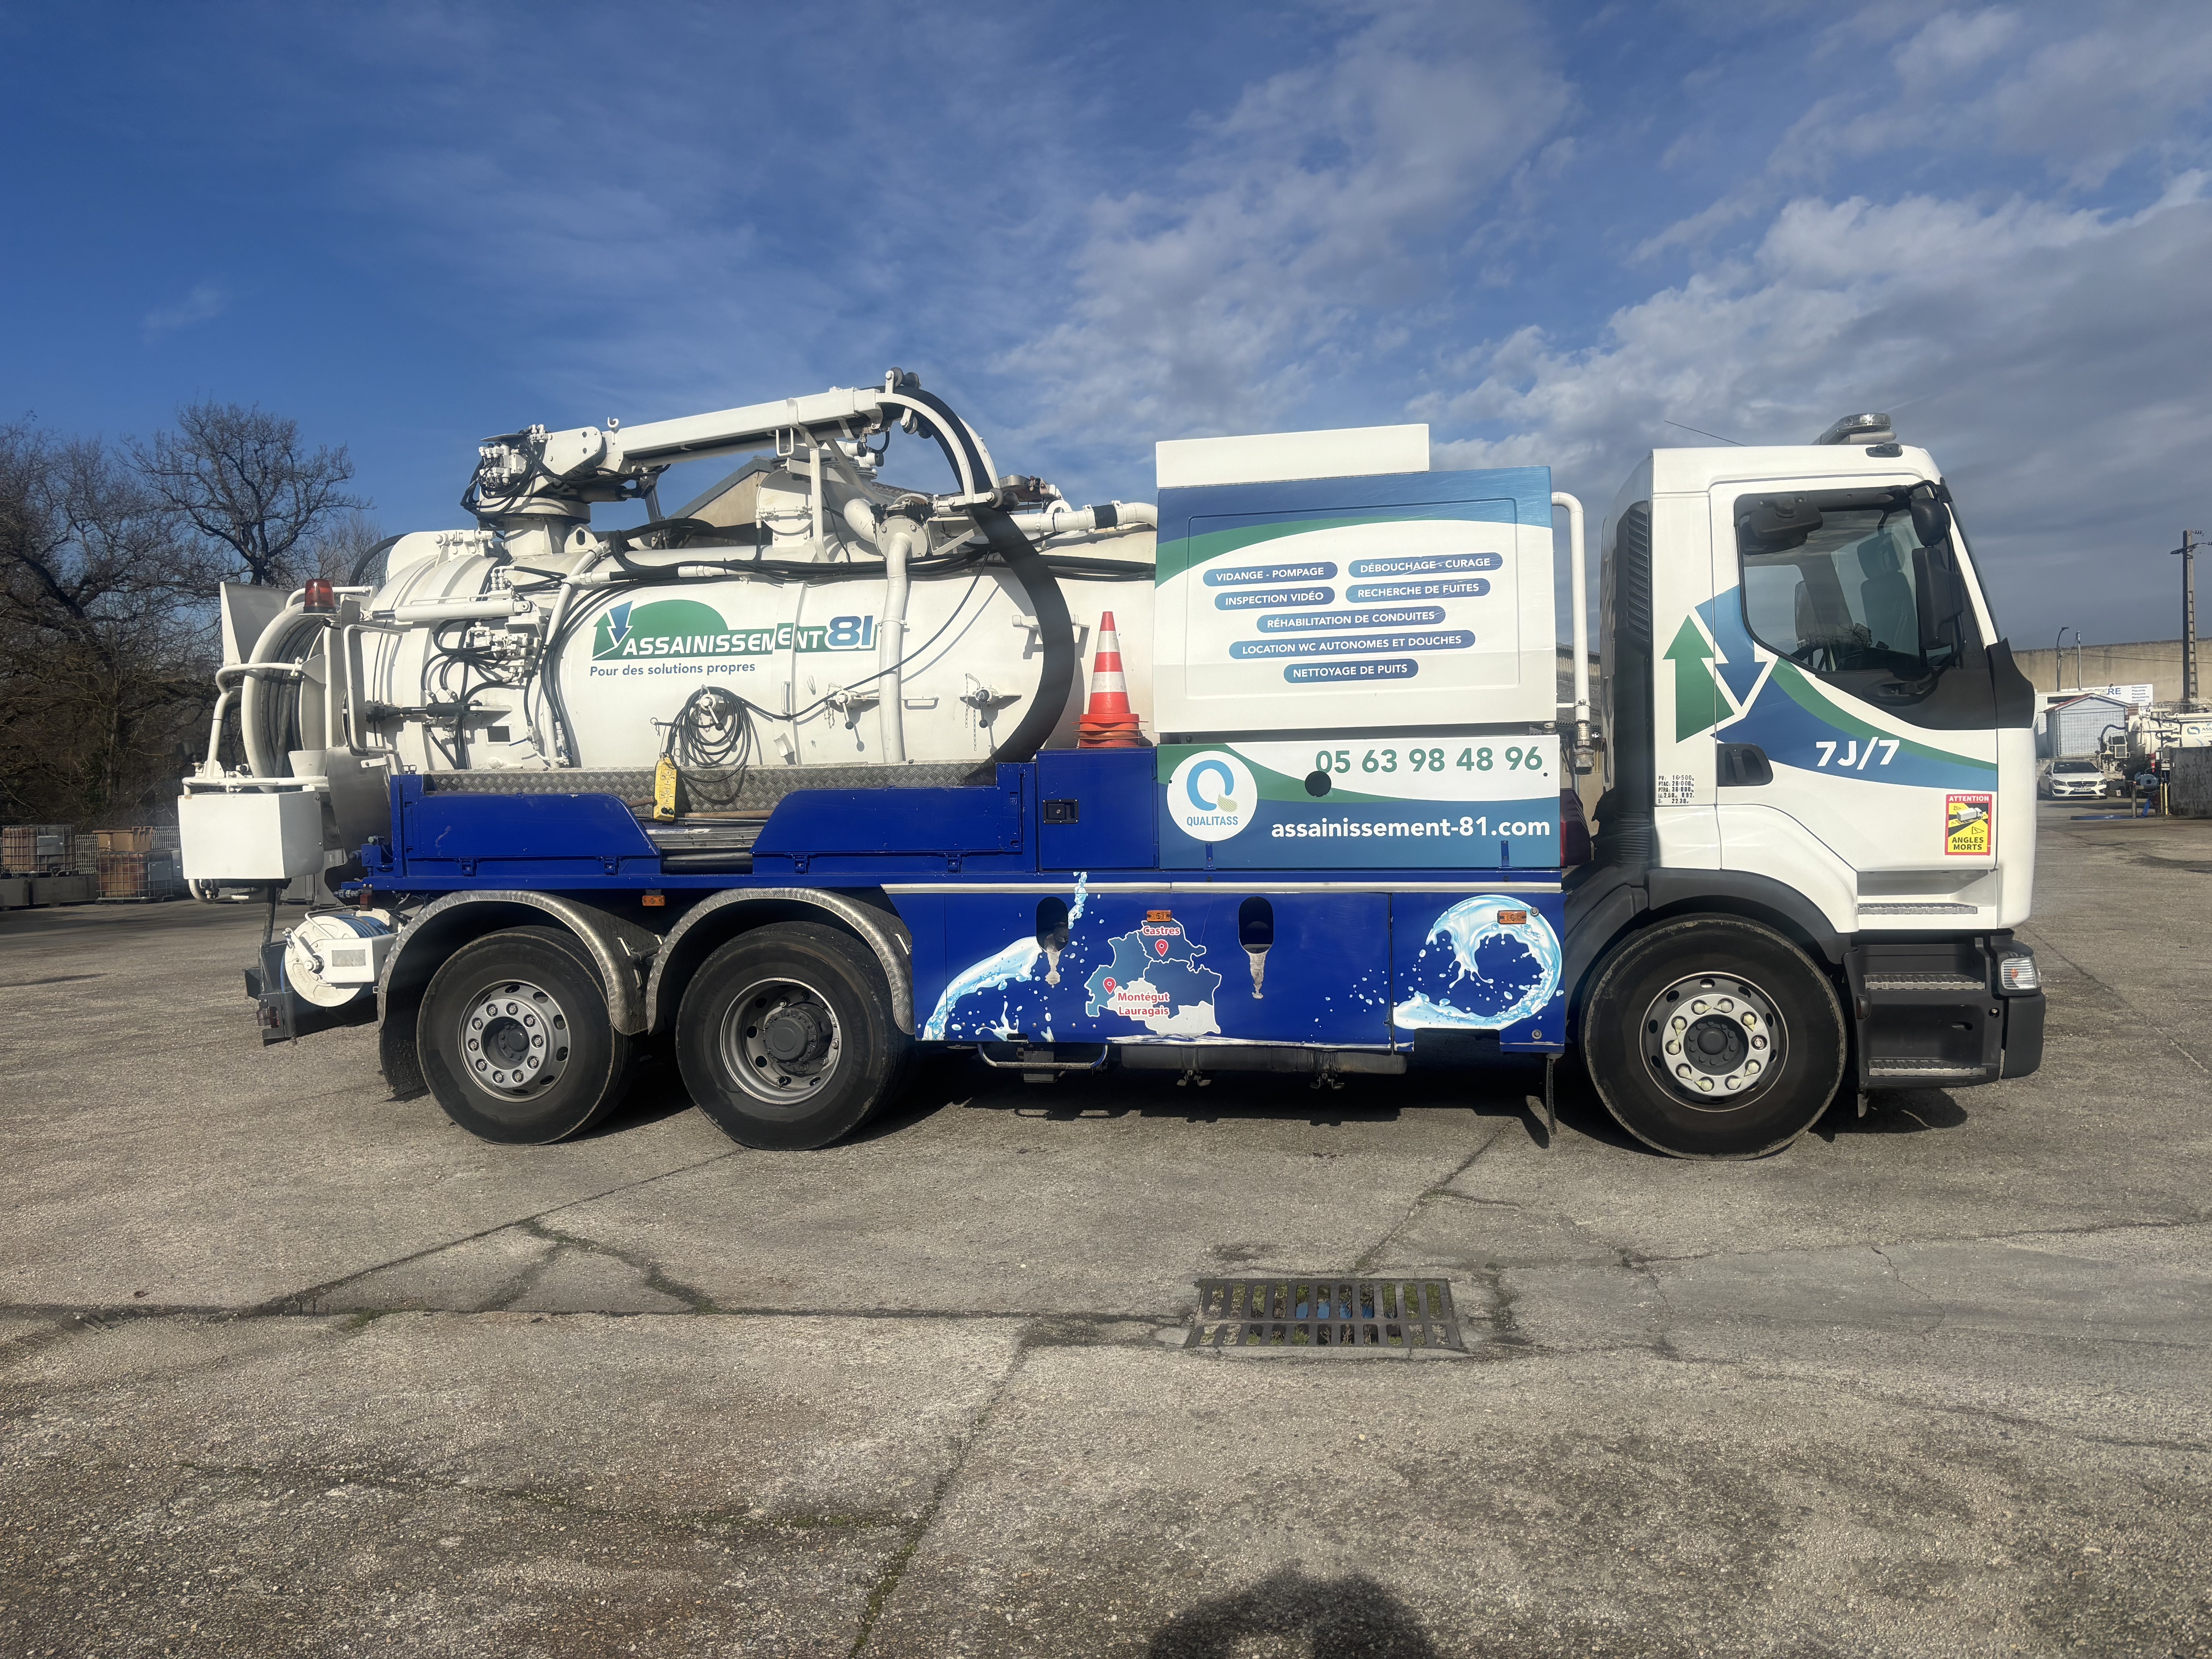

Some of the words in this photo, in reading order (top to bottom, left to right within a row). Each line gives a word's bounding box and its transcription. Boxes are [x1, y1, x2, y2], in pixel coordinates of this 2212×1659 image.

[1360, 562, 1436, 573] DÉBOUCHAGE
[1446, 558, 1490, 568] CURAGE
[1216, 571, 1263, 581] VIDANGE
[1273, 567, 1324, 577] POMPAGE
[1358, 587, 1421, 597] RECHERCHE
[1425, 586, 1439, 594] DE
[1443, 584, 1479, 592] FUITES
[1226, 594, 1287, 605] INSPECTION
[1290, 591, 1323, 601] VIDÉO
[1267, 615, 1351, 628] RÉHABILITATION
[1372, 611, 1434, 622] CONDUITES
[1243, 644, 1295, 654] LOCATION
[1298, 643, 1316, 651] WC
[1319, 639, 1389, 650] AUTONOMES
[1393, 639, 1405, 647] ET
[1409, 636, 1461, 646] DOUCHES
[590, 666, 618, 676] Pour
[623, 665, 643, 675] des
[648, 663, 702, 674] solutions
[707, 664, 755, 675] propres
[1293, 667, 1356, 677] NETTOYAGE
[1360, 666, 1374, 674] DE
[1378, 664, 1407, 673] PUITS
[1316, 750, 1350, 774] 05
[1362, 749, 1397, 773] 63
[1409, 748, 1444, 771] 98
[1456, 747, 1493, 771] 48
[1505, 747, 1542, 770] 96
[1816, 737, 1900, 770] 7J/7
[1187, 816, 1238, 826] QUALITASS
[1272, 817, 1549, 837] assainissement-81.com
[1143, 926, 1180, 934] Castres
[1118, 992, 1168, 1003] Montégut
[1119, 1006, 1169, 1017] Lauragais
